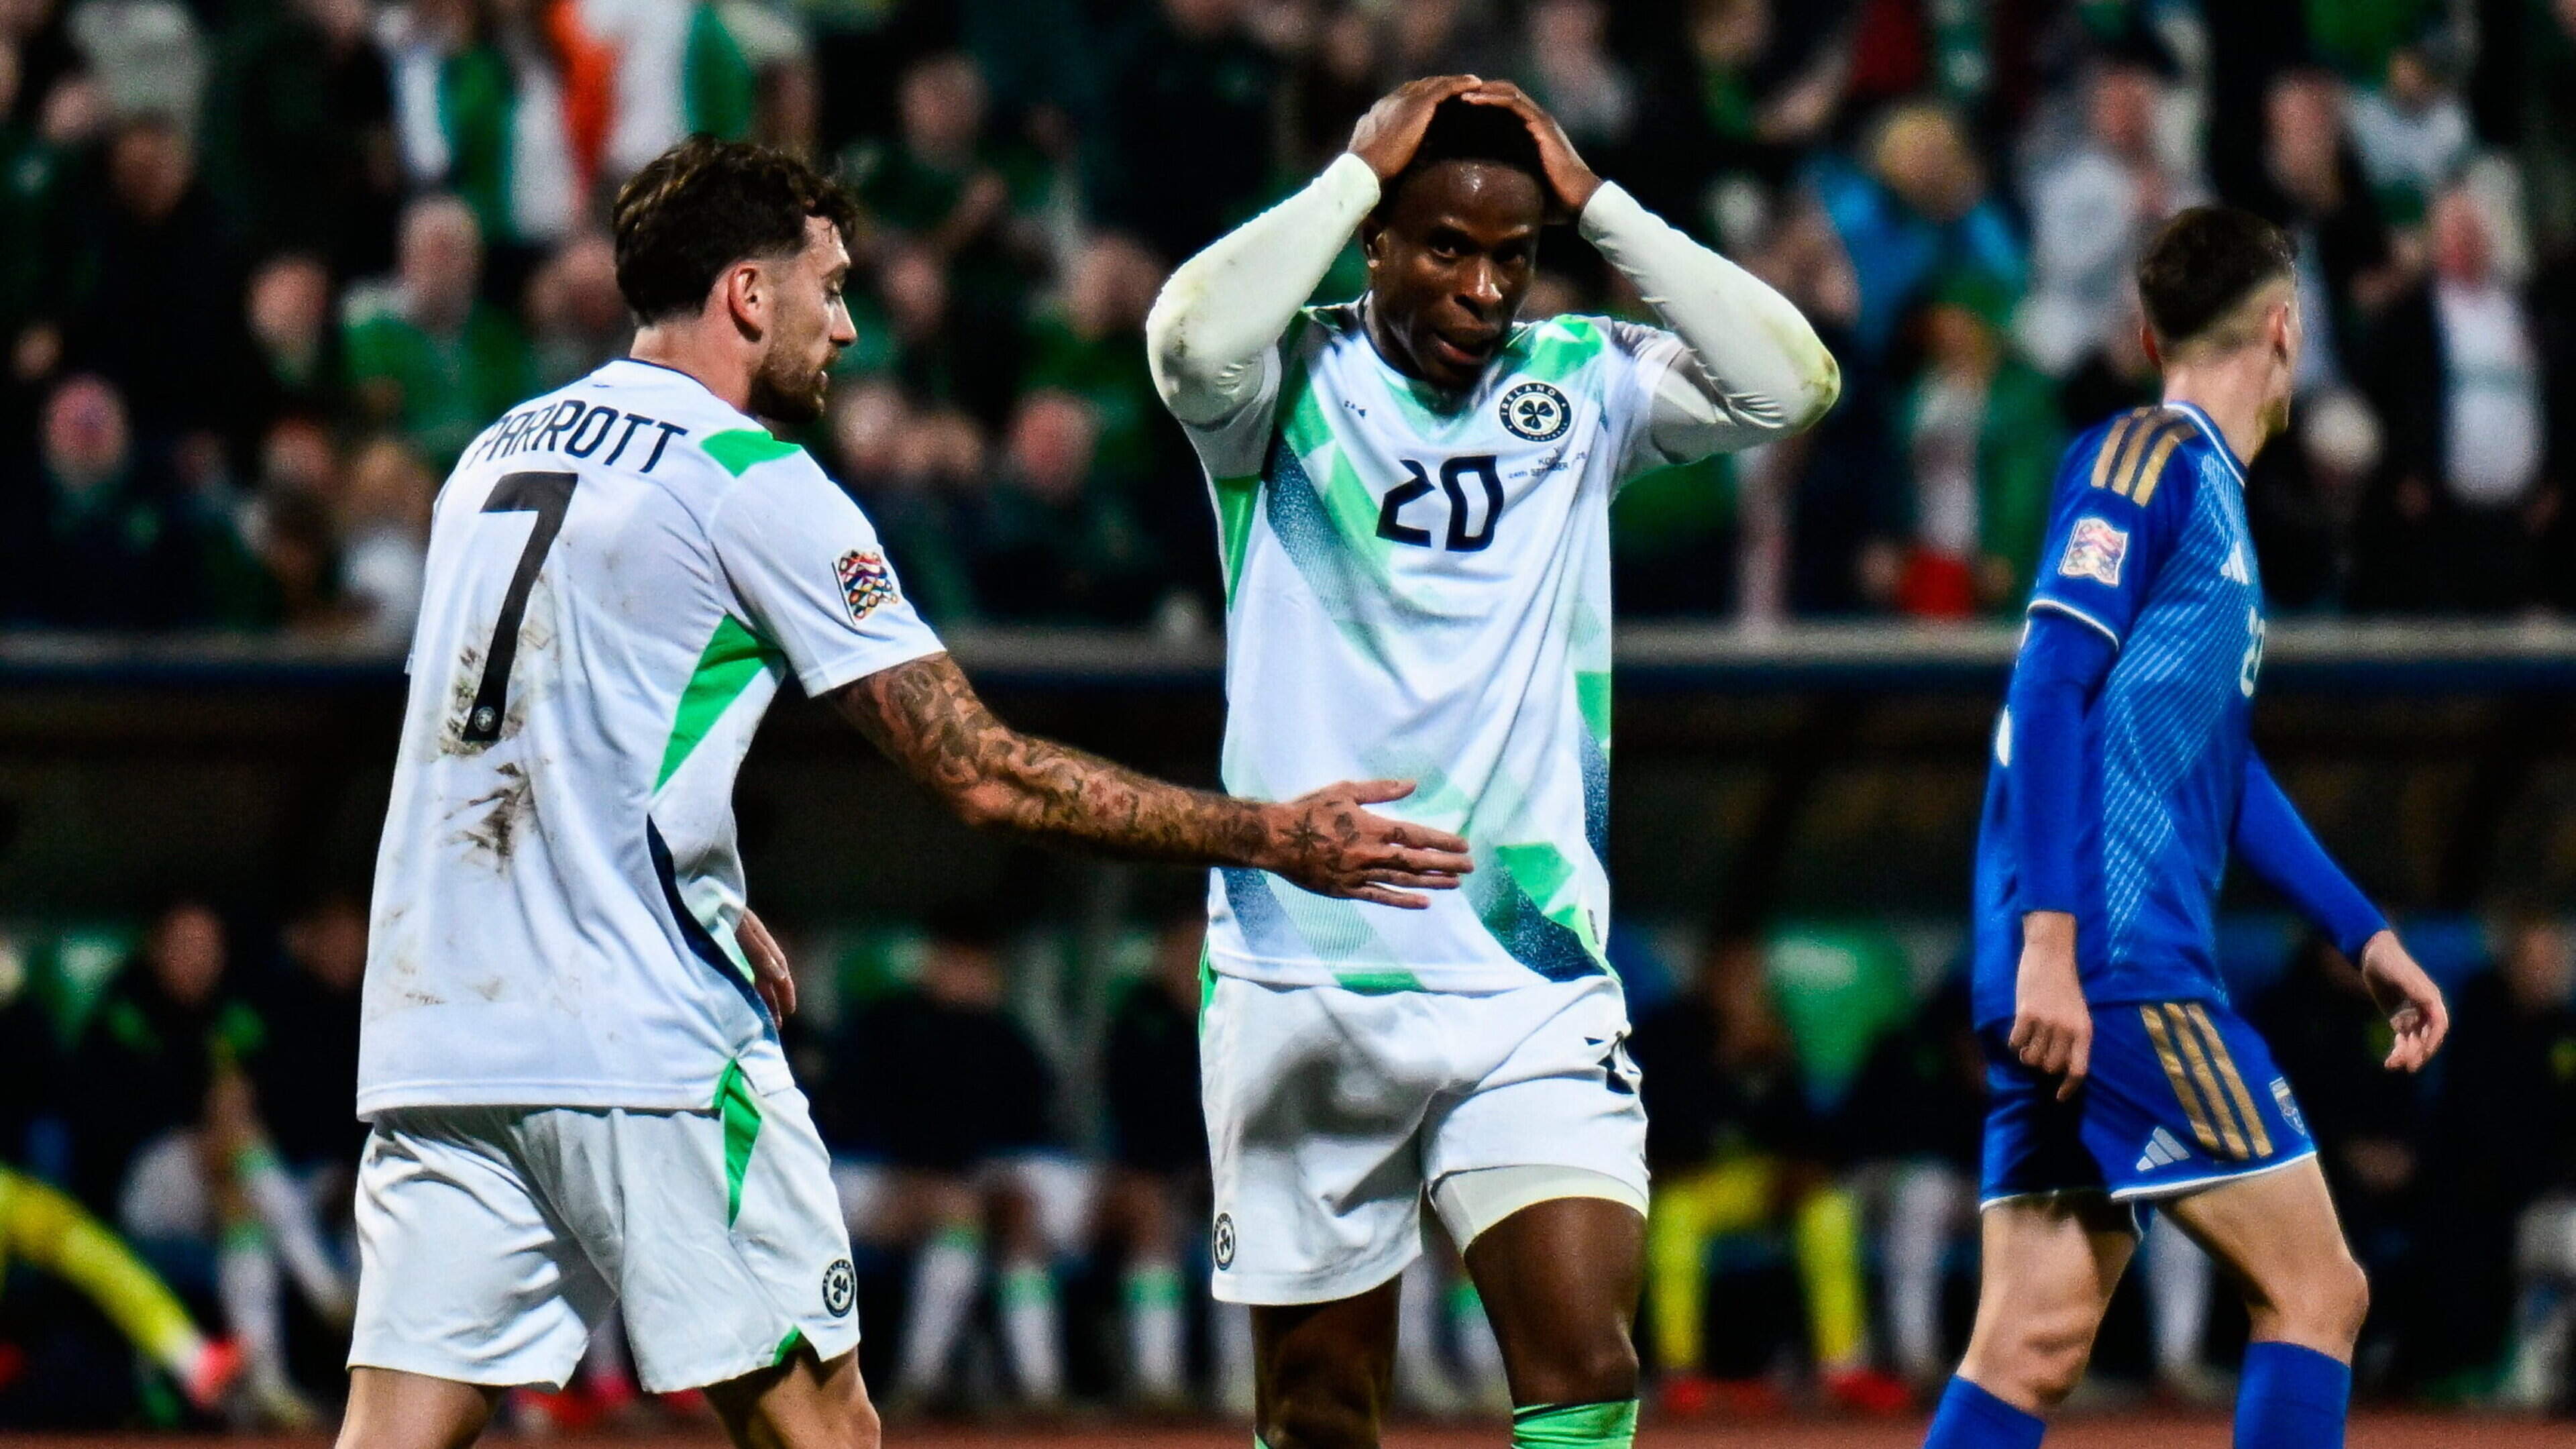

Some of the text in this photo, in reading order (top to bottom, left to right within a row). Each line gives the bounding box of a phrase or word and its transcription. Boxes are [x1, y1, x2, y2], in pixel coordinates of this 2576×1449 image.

[466, 400, 688, 473] PARROTT
[1501, 384, 1556, 415] IRELAND
[1376, 455, 1503, 552] 20
[462, 471, 578, 741] 7
